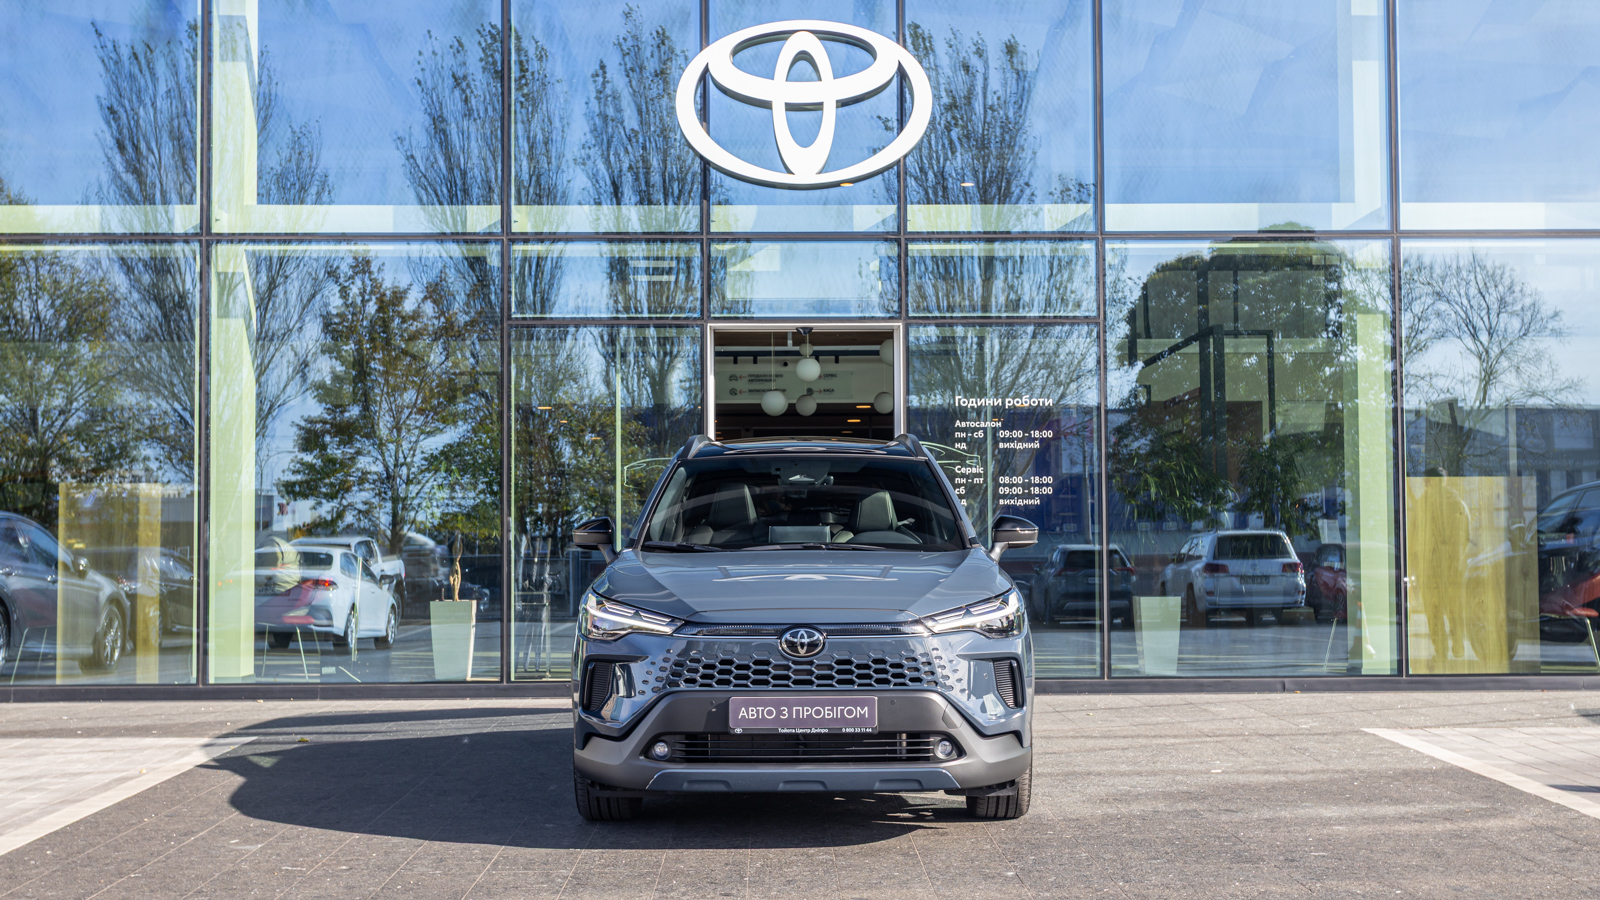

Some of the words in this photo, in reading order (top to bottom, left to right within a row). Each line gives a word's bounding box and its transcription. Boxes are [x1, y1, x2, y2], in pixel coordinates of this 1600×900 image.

[955, 396, 1002, 407] Години
[1005, 395, 1053, 409] роботи
[955, 420, 1002, 428] Автосалон
[973, 430, 984, 438] сб
[999, 430, 1023, 438] 09:00
[1030, 430, 1053, 438] 18:00
[955, 442, 967, 450] нд
[999, 441, 1040, 450] вихідний
[955, 465, 984, 475] Сервіс
[999, 476, 1023, 484] 08:00
[1030, 476, 1053, 484] 18:00
[999, 487, 1023, 495] 09:00
[1030, 487, 1053, 495] 18:00
[999, 497, 1040, 506] вихідний
[738, 707, 776, 719] АВТО
[793, 706, 869, 719] ПРОБІГОМ
